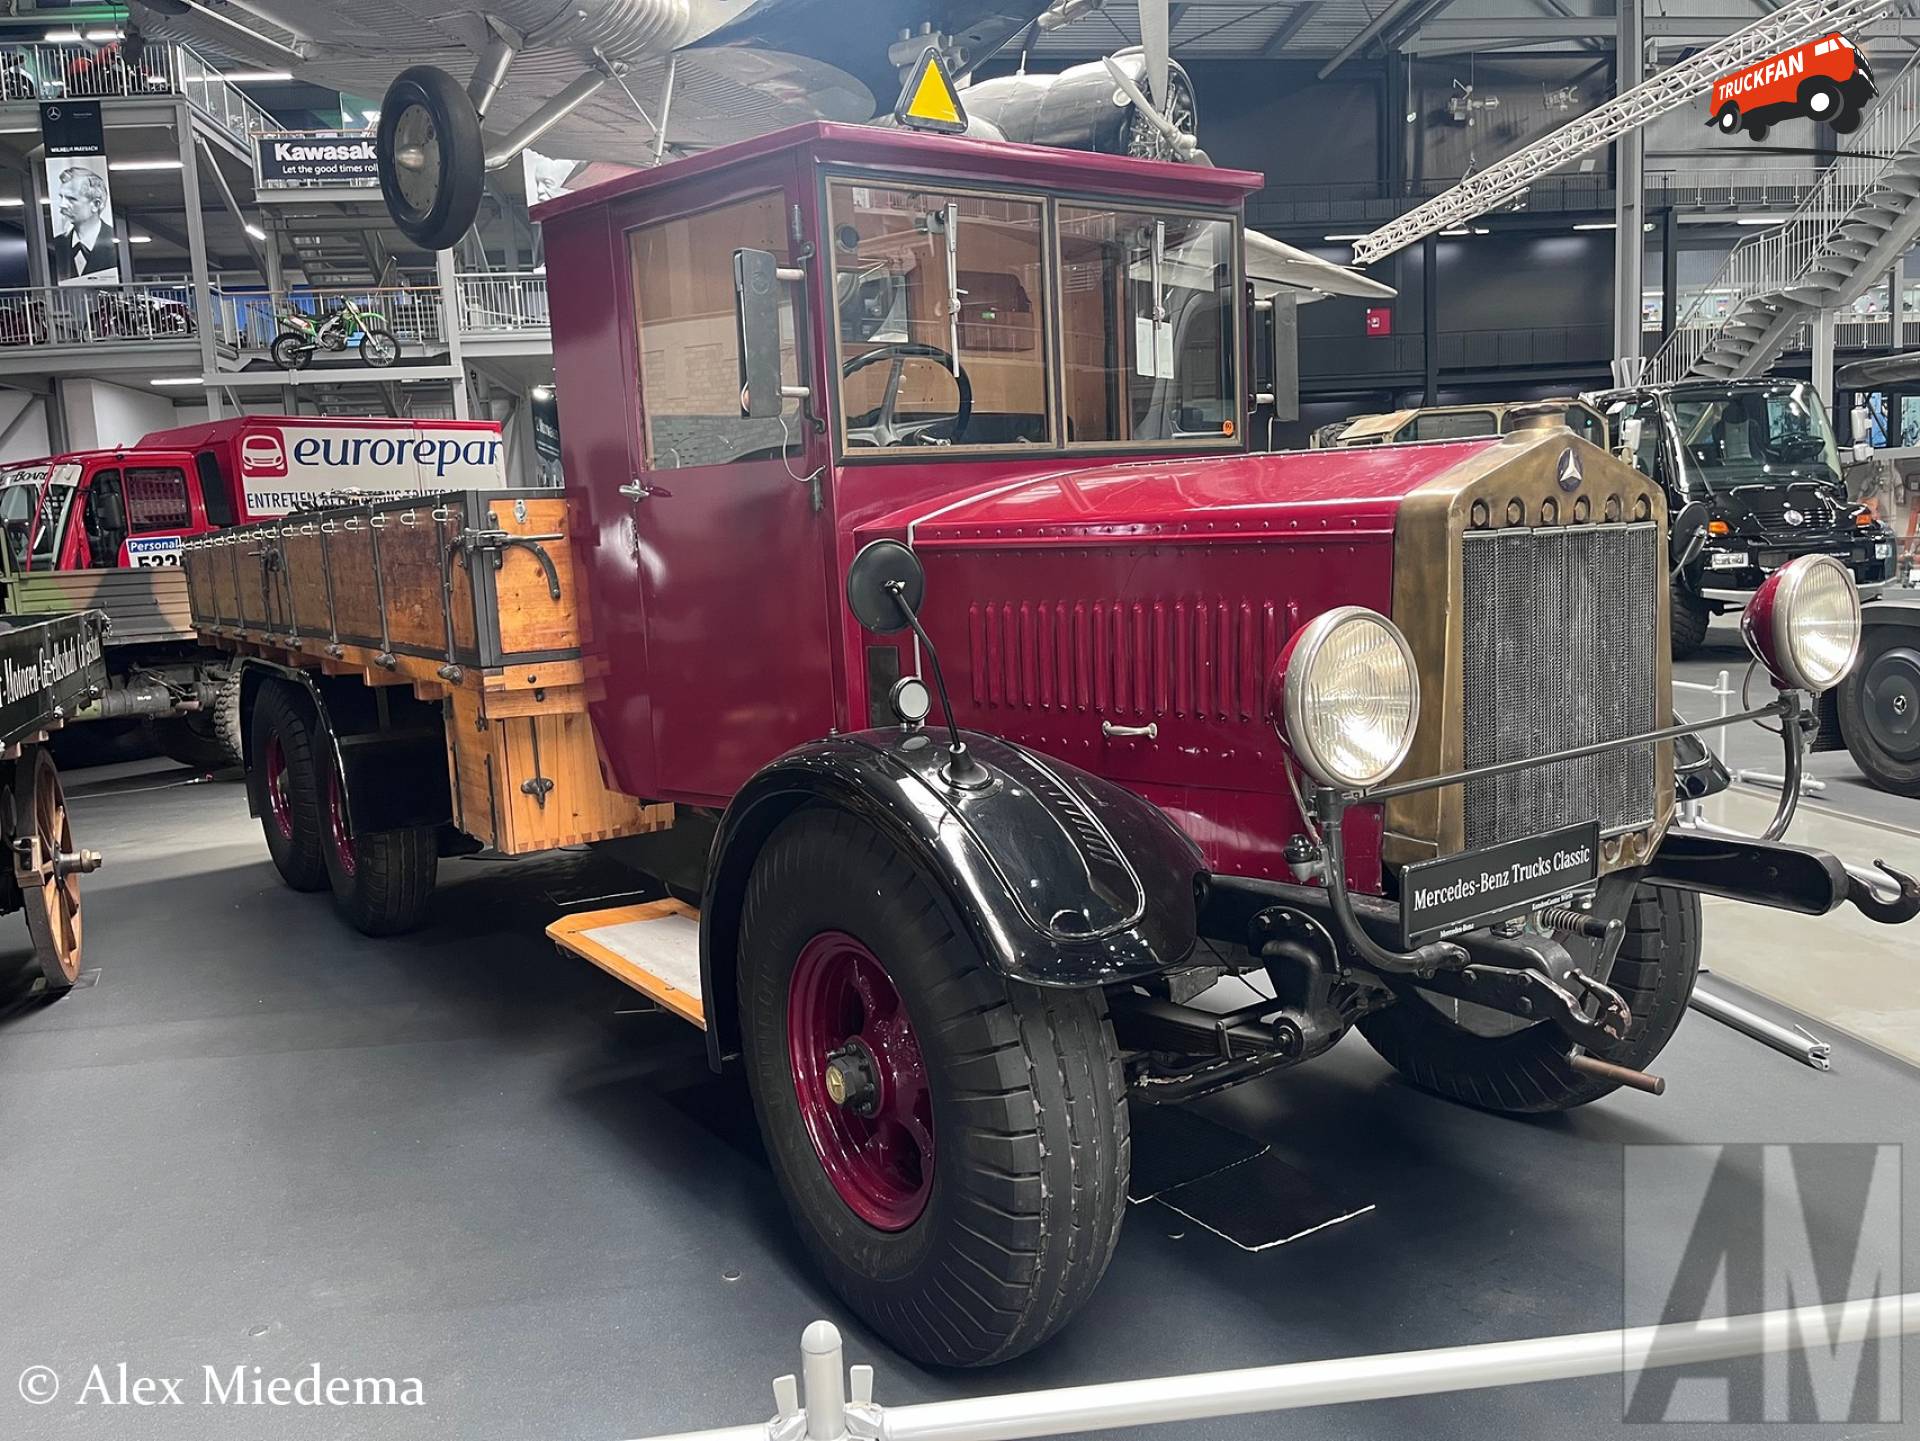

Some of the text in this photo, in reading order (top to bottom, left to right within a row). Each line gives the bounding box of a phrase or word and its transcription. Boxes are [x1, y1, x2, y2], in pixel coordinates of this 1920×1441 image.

[274, 141, 377, 161] Kawasak
[283, 164, 297, 174] Let
[298, 163, 313, 174] the
[314, 164, 338, 175] good
[339, 164, 363, 173] times
[294, 437, 503, 477] eurorepar
[130, 539, 178, 552] Personal
[1413, 844, 1591, 912] Mercedes-Benz Trucks Classic
